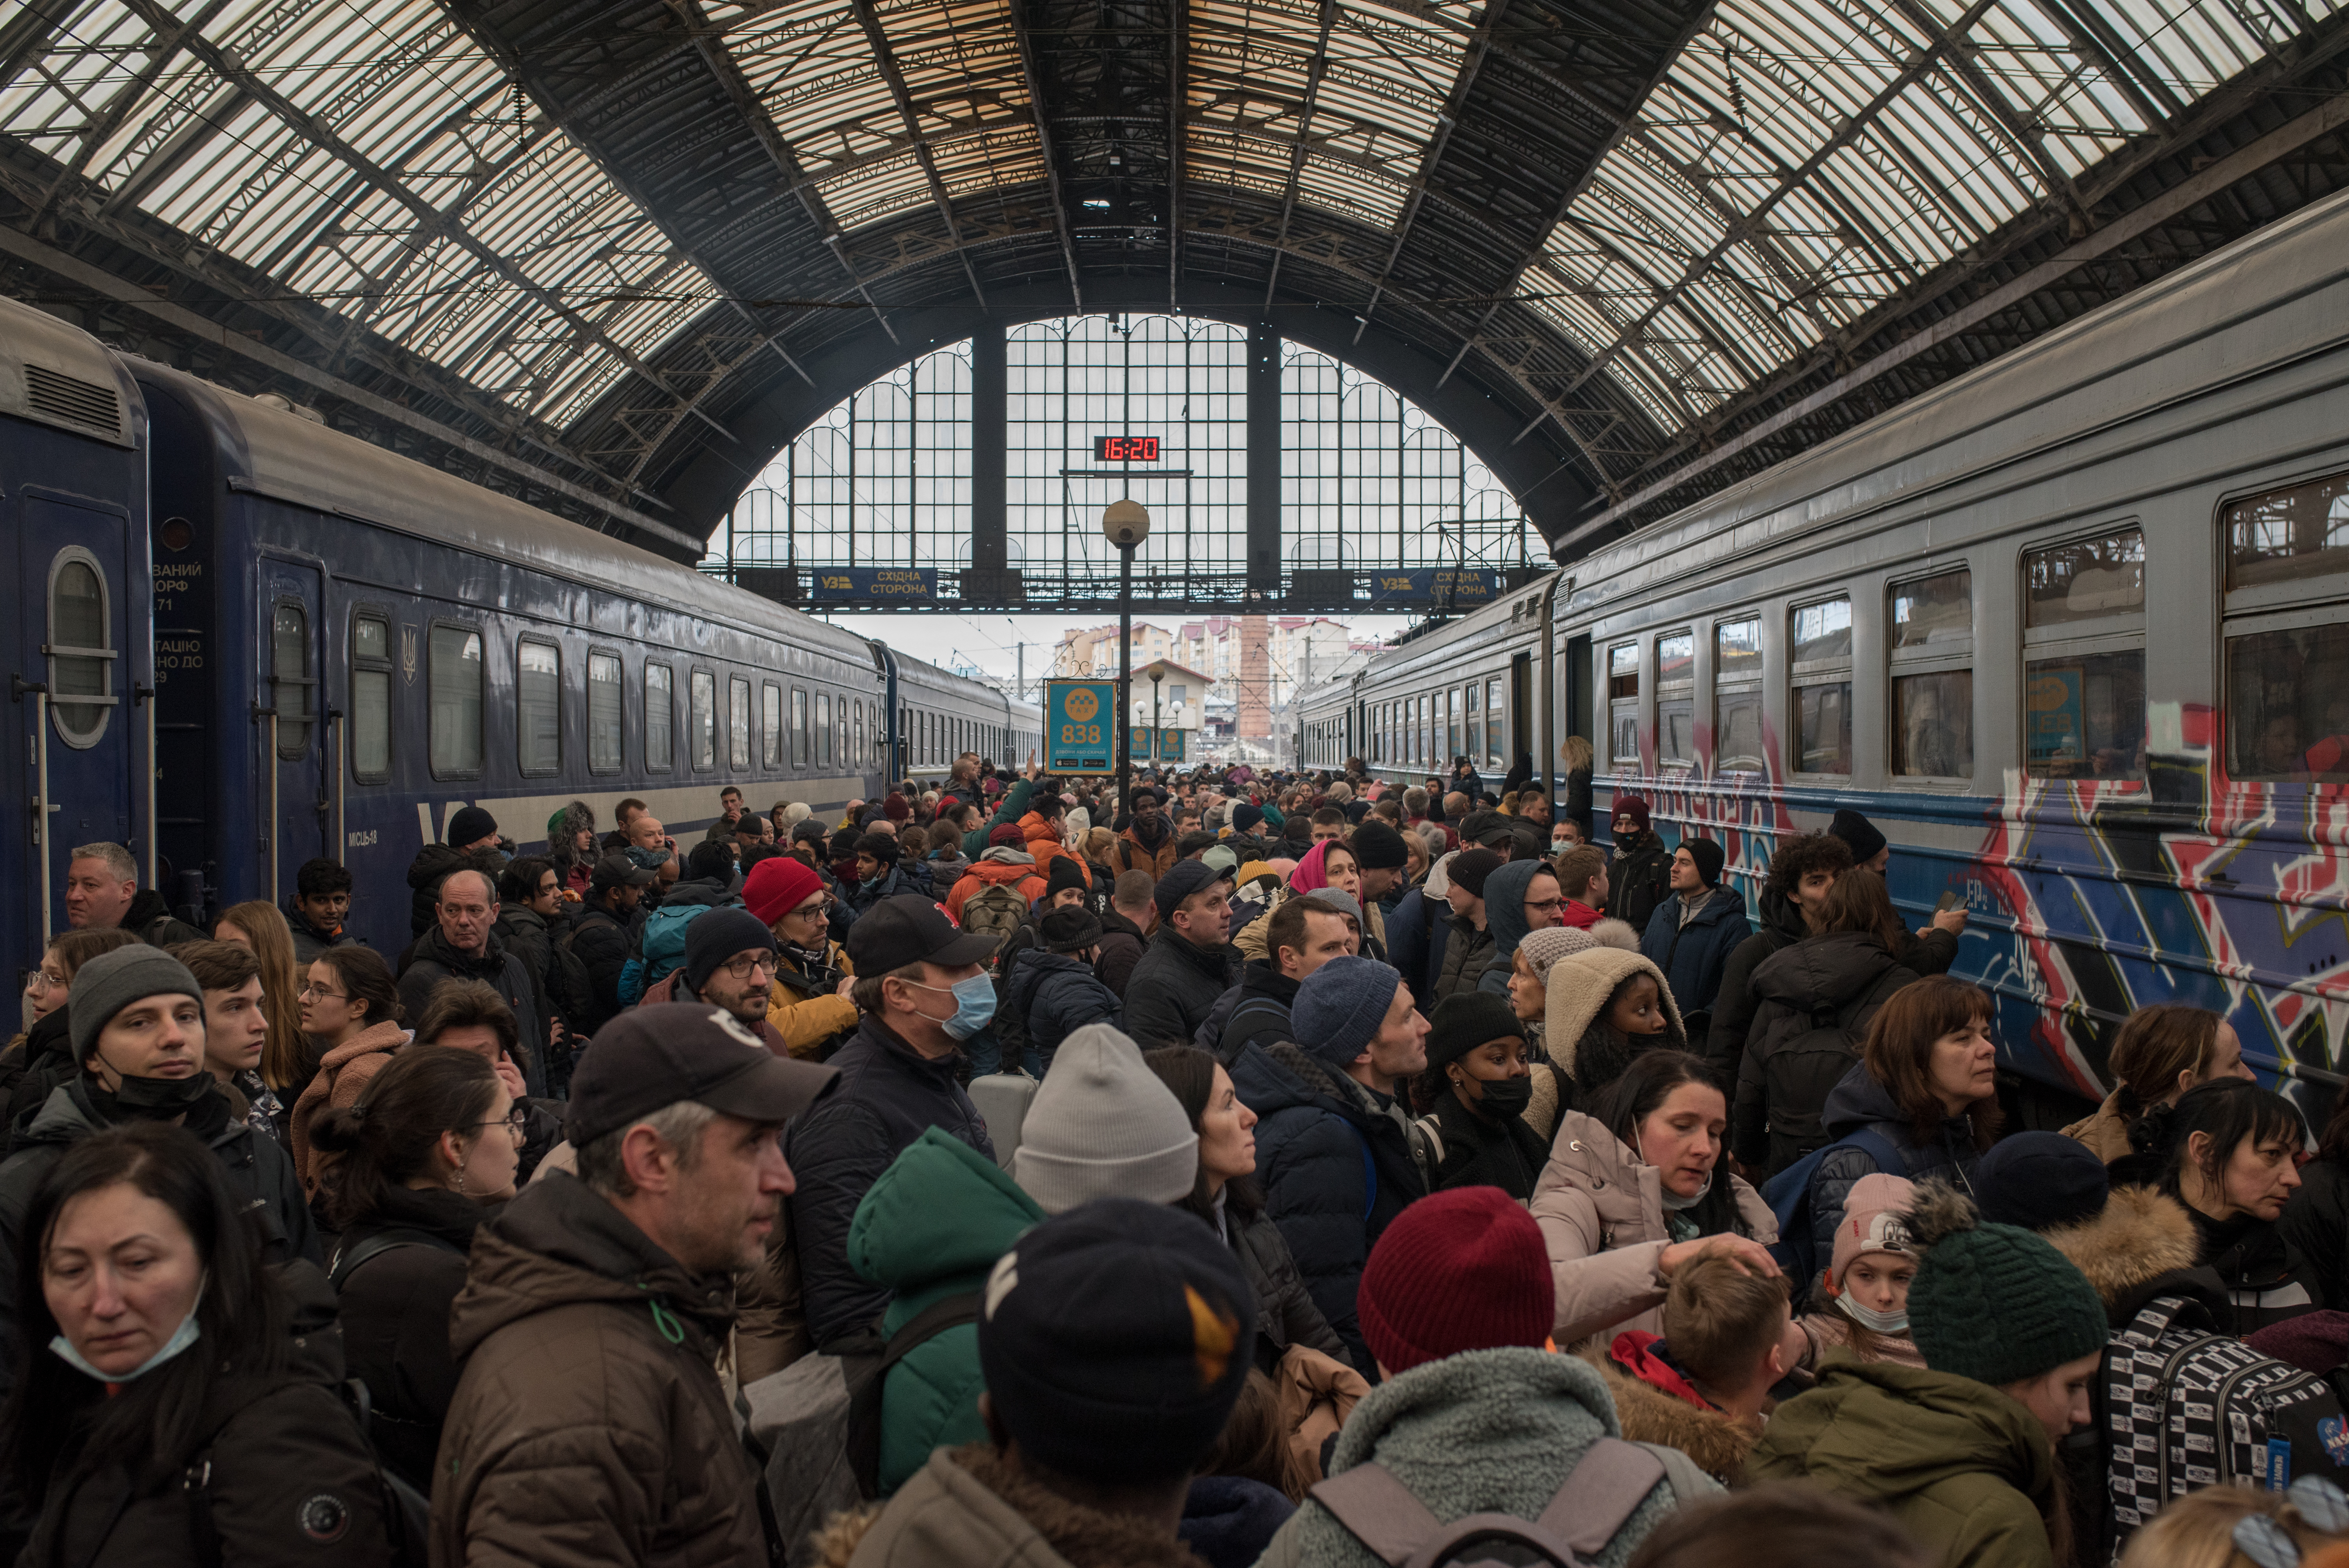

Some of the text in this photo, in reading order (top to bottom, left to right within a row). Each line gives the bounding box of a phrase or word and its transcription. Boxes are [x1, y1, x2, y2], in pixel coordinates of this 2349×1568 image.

[1105, 438, 1158, 460] 16:20
[877, 572, 921, 582] СХІДНА
[870, 584, 928, 594] СТОРОНА
[182, 656, 203, 668] ДО
[1061, 724, 1101, 744] 838
[2274, 1455, 2283, 1481] REMOVE
